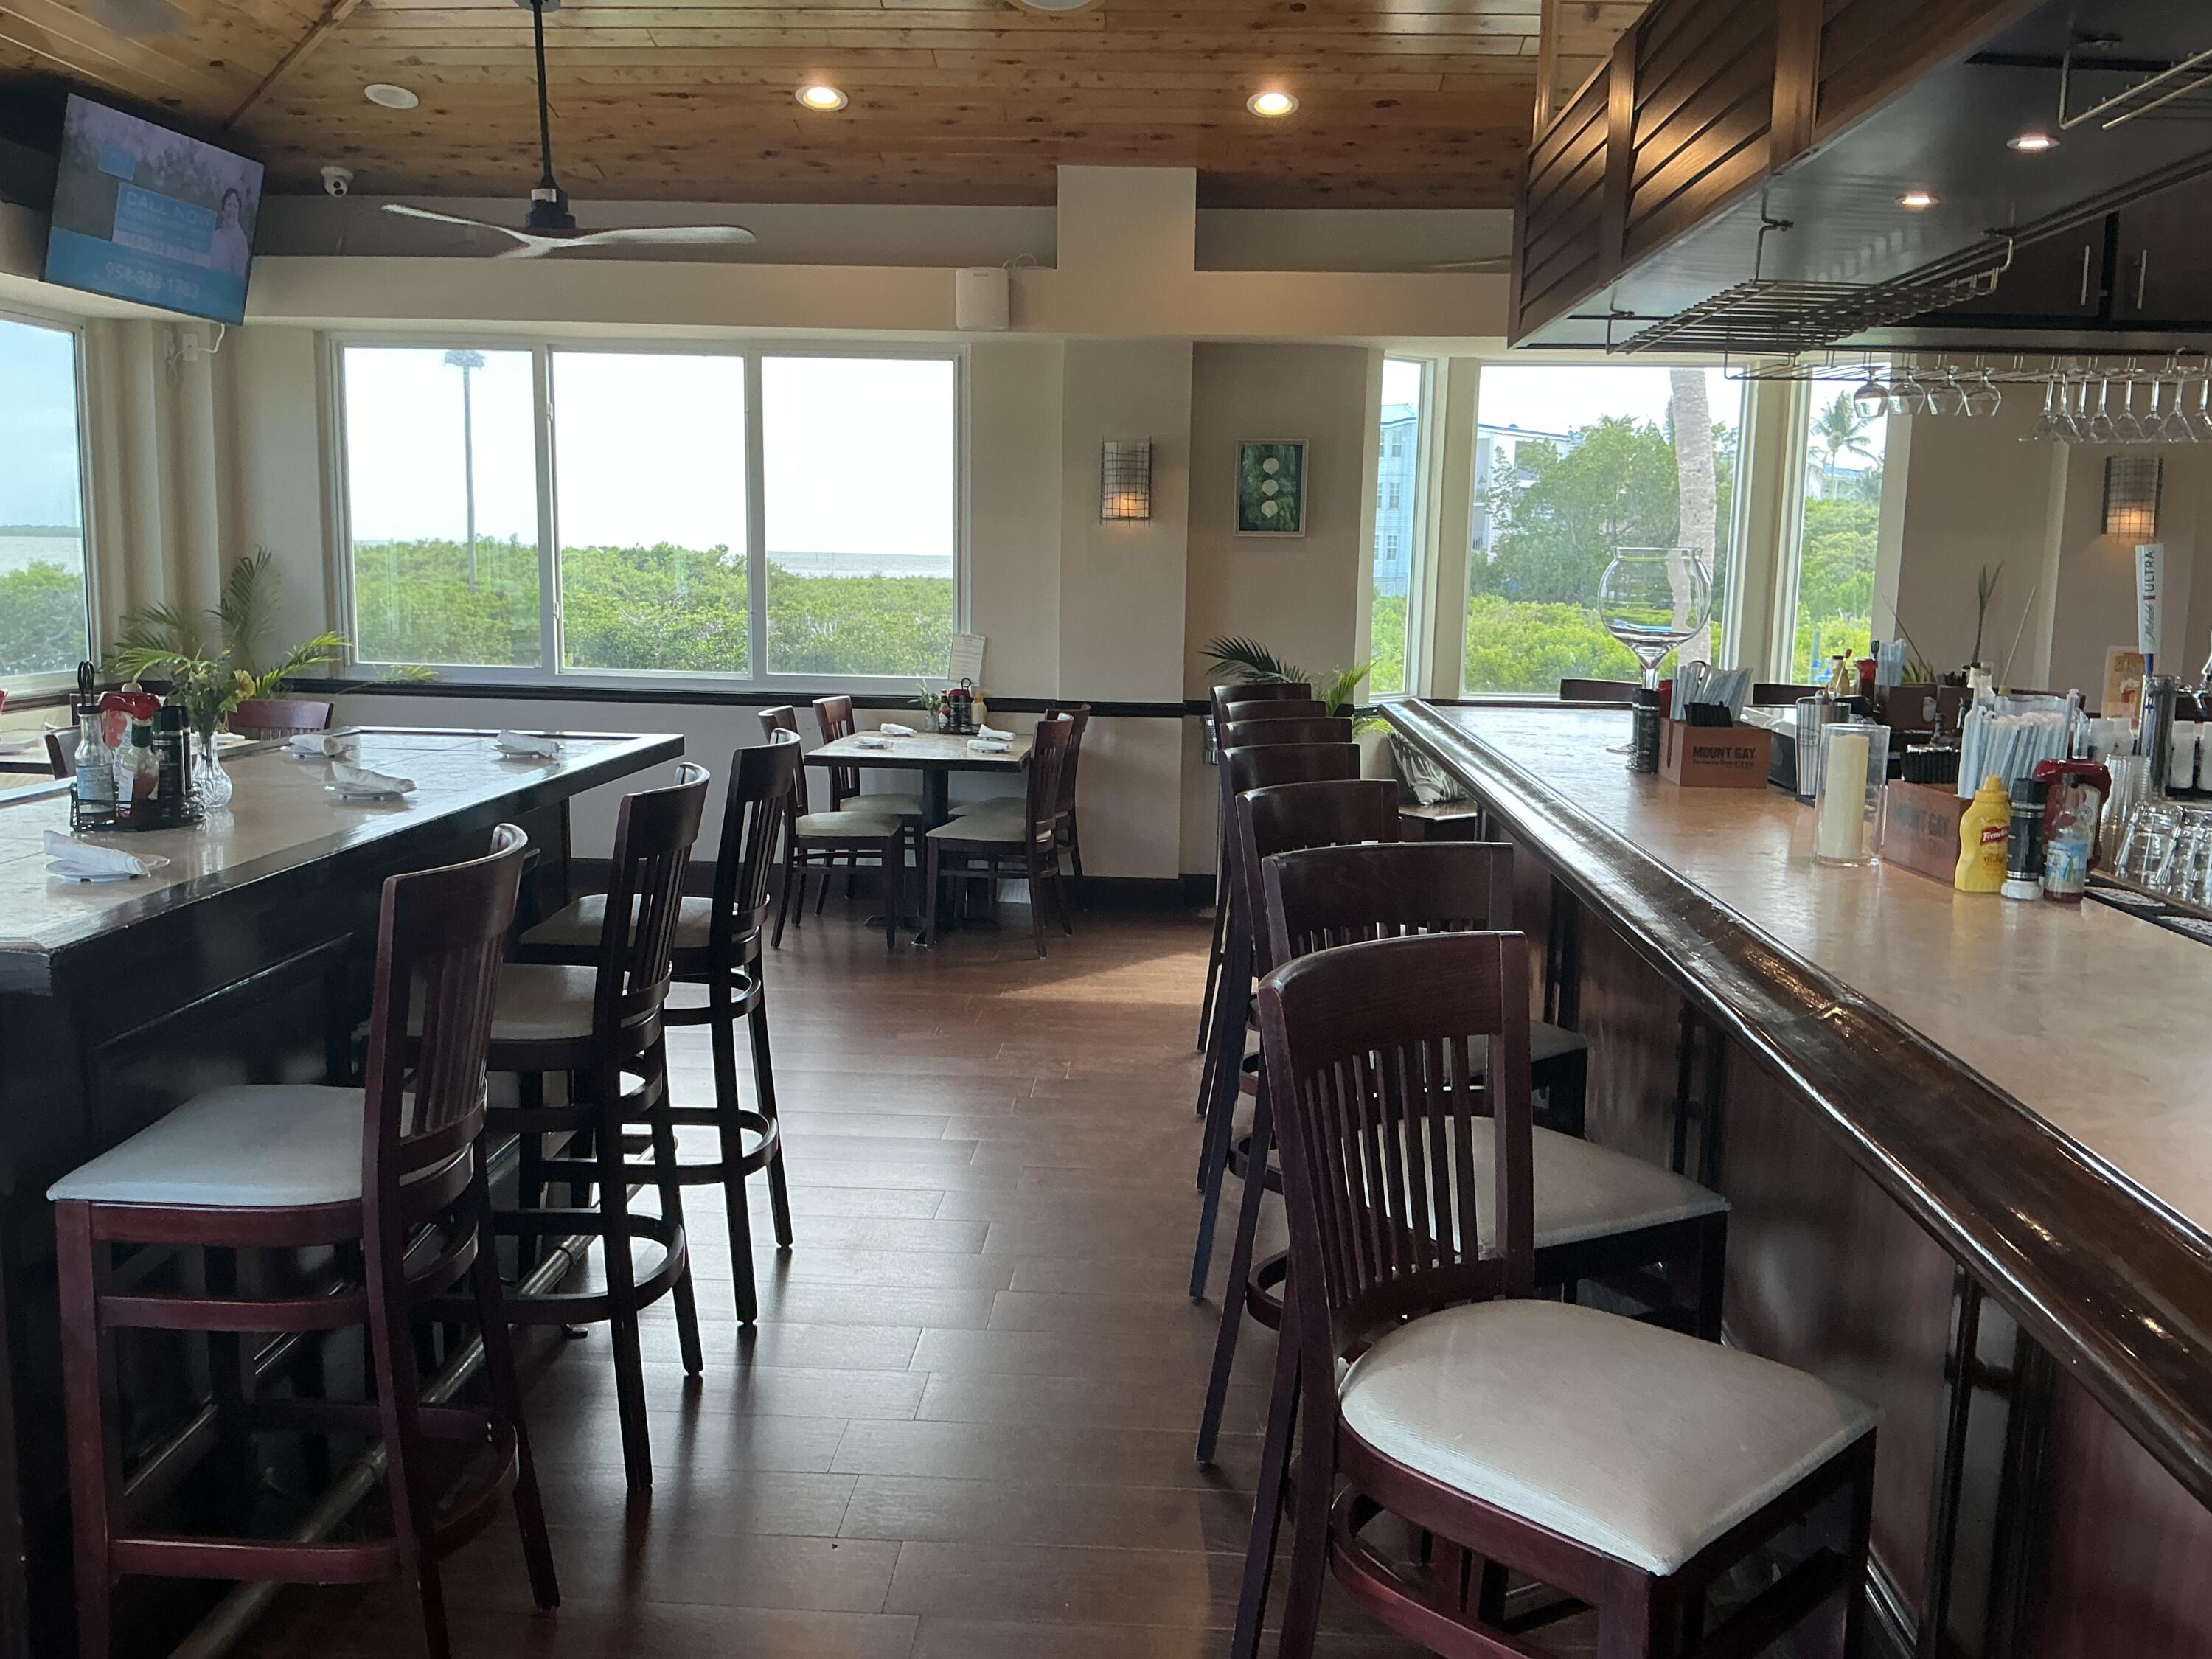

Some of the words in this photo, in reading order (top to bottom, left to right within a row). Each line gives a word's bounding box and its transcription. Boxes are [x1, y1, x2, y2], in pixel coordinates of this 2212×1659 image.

[125, 190, 167, 215] CALL
[172, 206, 212, 227] NOW
[2144, 551, 2155, 592] ULTRA
[1693, 746, 1733, 759] MOUNT
